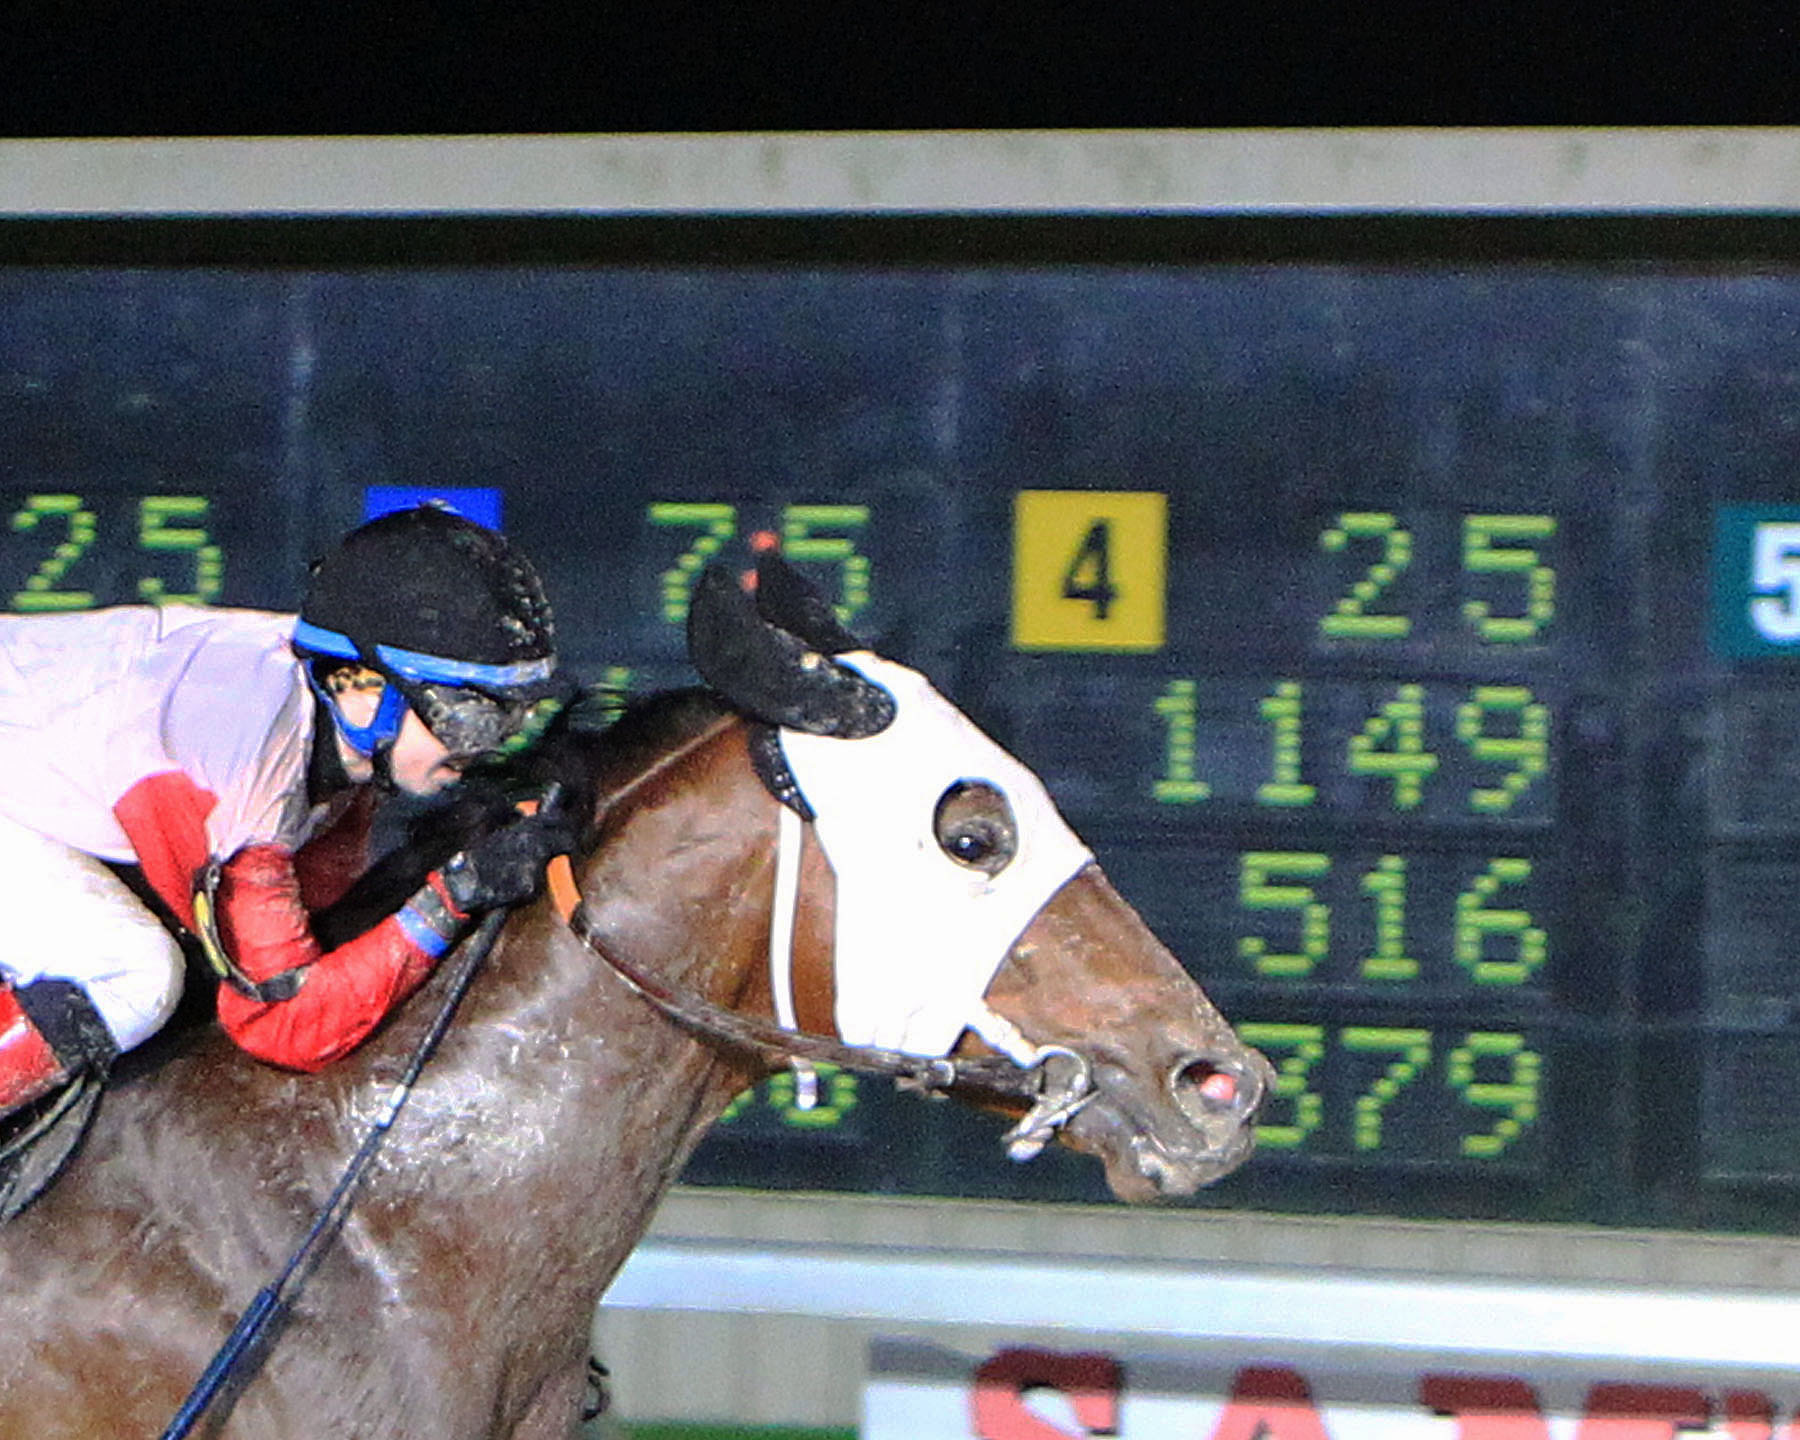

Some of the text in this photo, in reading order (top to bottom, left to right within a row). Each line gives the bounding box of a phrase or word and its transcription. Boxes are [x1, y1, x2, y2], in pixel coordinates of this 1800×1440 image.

[12, 494, 224, 608] 25
[1061, 515, 1115, 621] 4
[1319, 510, 1556, 643] 25
[1751, 520, 1800, 643] 5
[1153, 680, 1549, 809] 1149
[1237, 851, 1546, 985] 516
